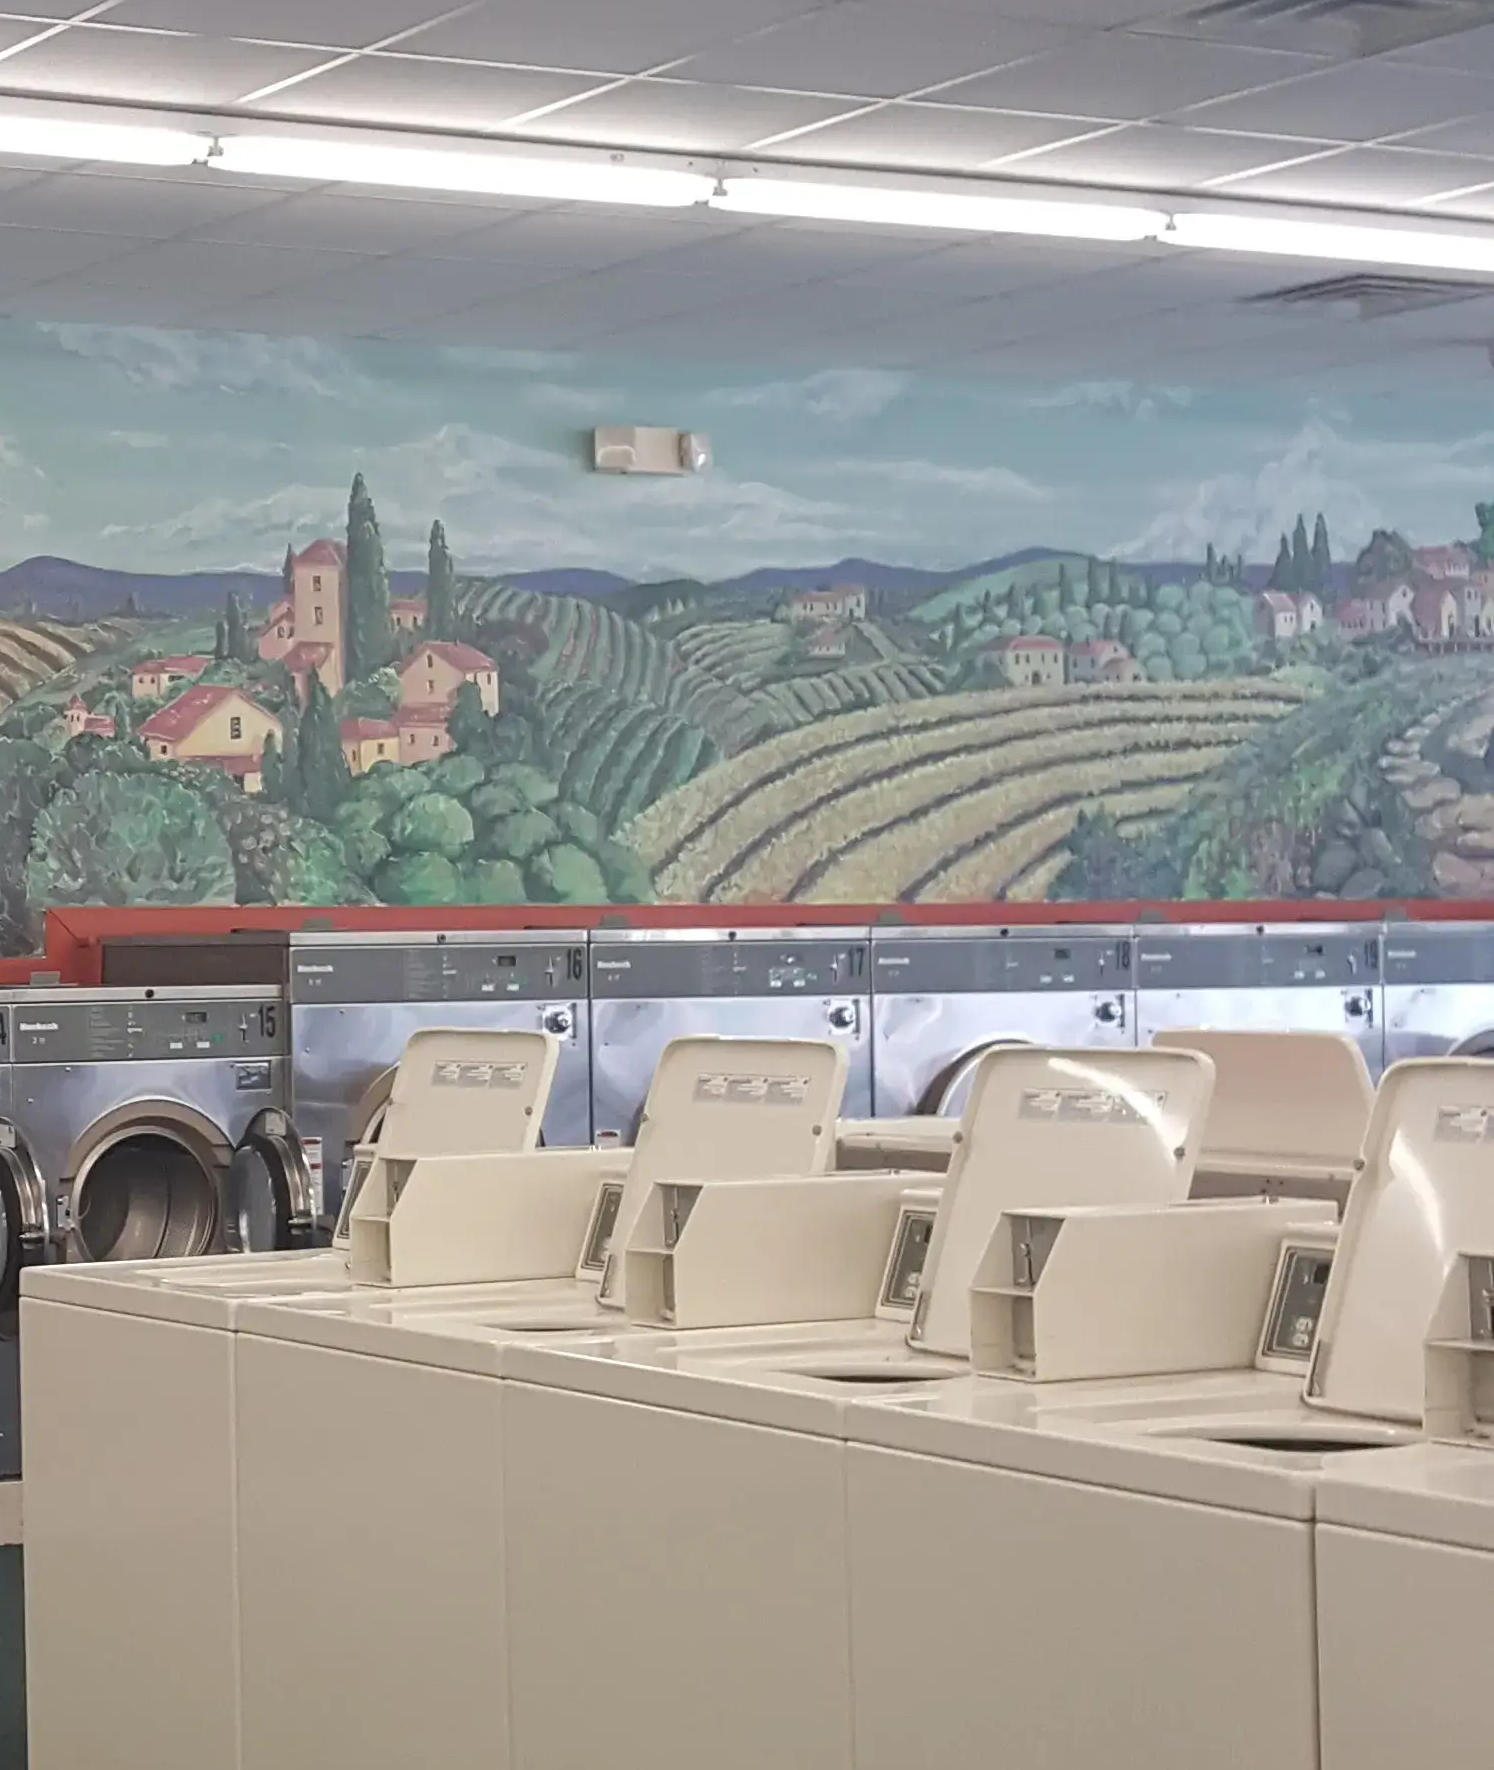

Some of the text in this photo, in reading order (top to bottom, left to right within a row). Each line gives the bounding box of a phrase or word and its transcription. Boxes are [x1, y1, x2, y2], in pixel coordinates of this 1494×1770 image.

[566, 948, 582, 980] 16
[848, 946, 866, 977] 17
[1115, 940, 1131, 970] 18
[258, 1005, 276, 1038] 15
